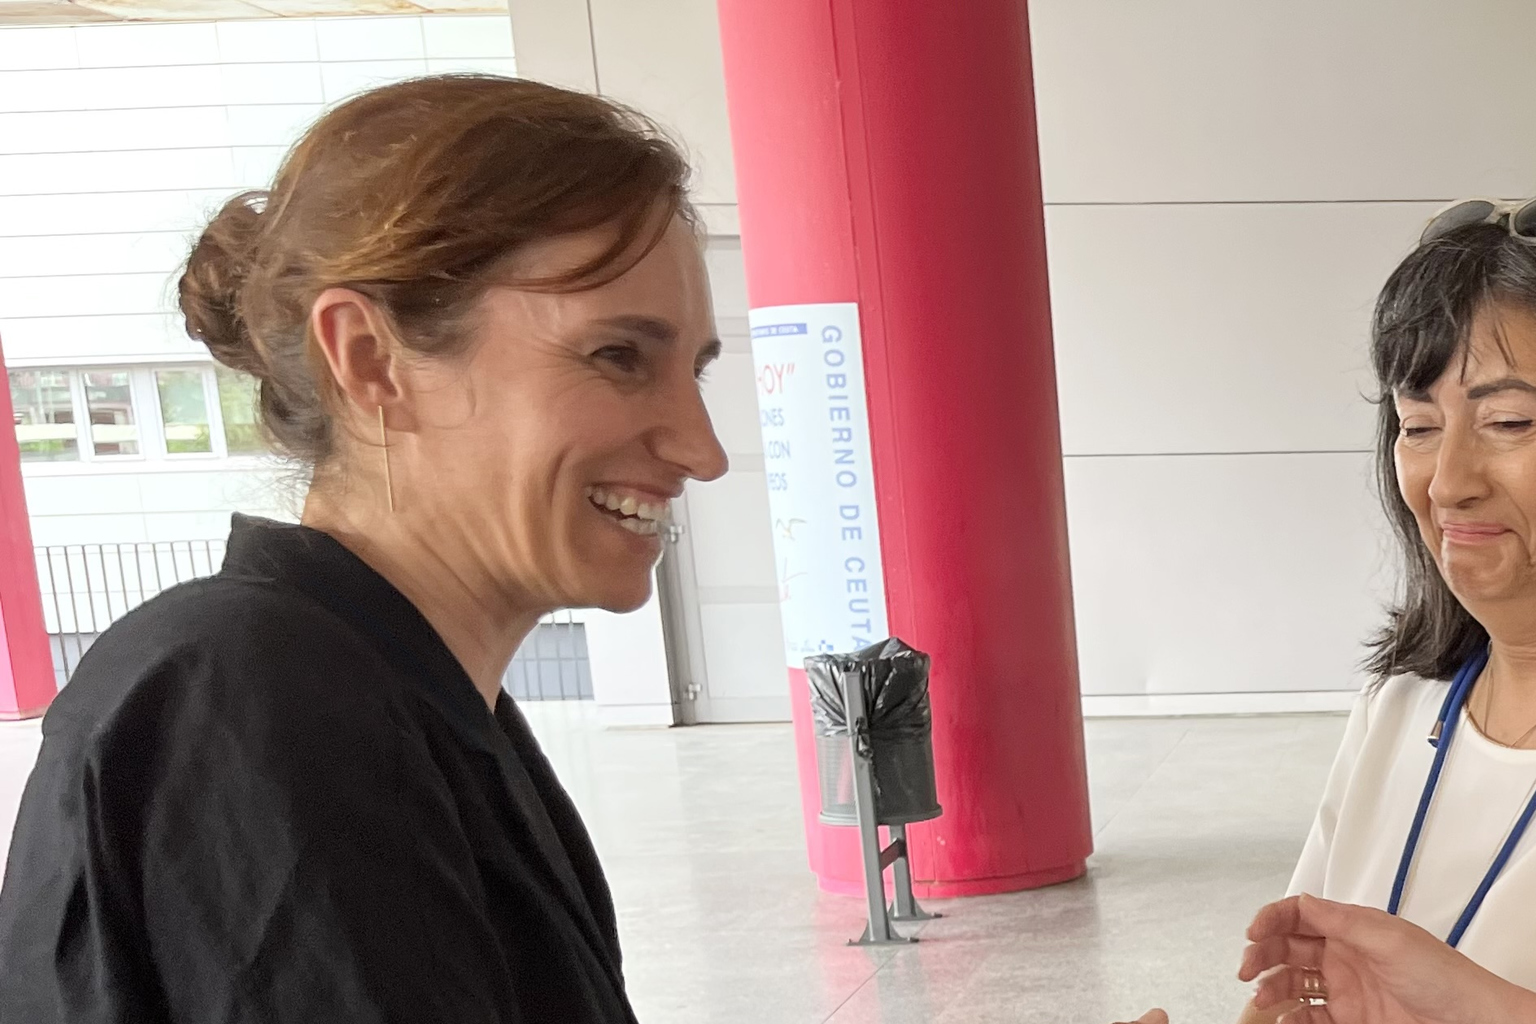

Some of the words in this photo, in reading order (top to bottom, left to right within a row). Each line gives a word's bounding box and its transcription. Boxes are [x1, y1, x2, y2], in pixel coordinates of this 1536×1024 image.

[821, 325, 857, 488] GOBIERNO
[840, 505, 862, 541] DE
[845, 557, 871, 651] CEUTA
